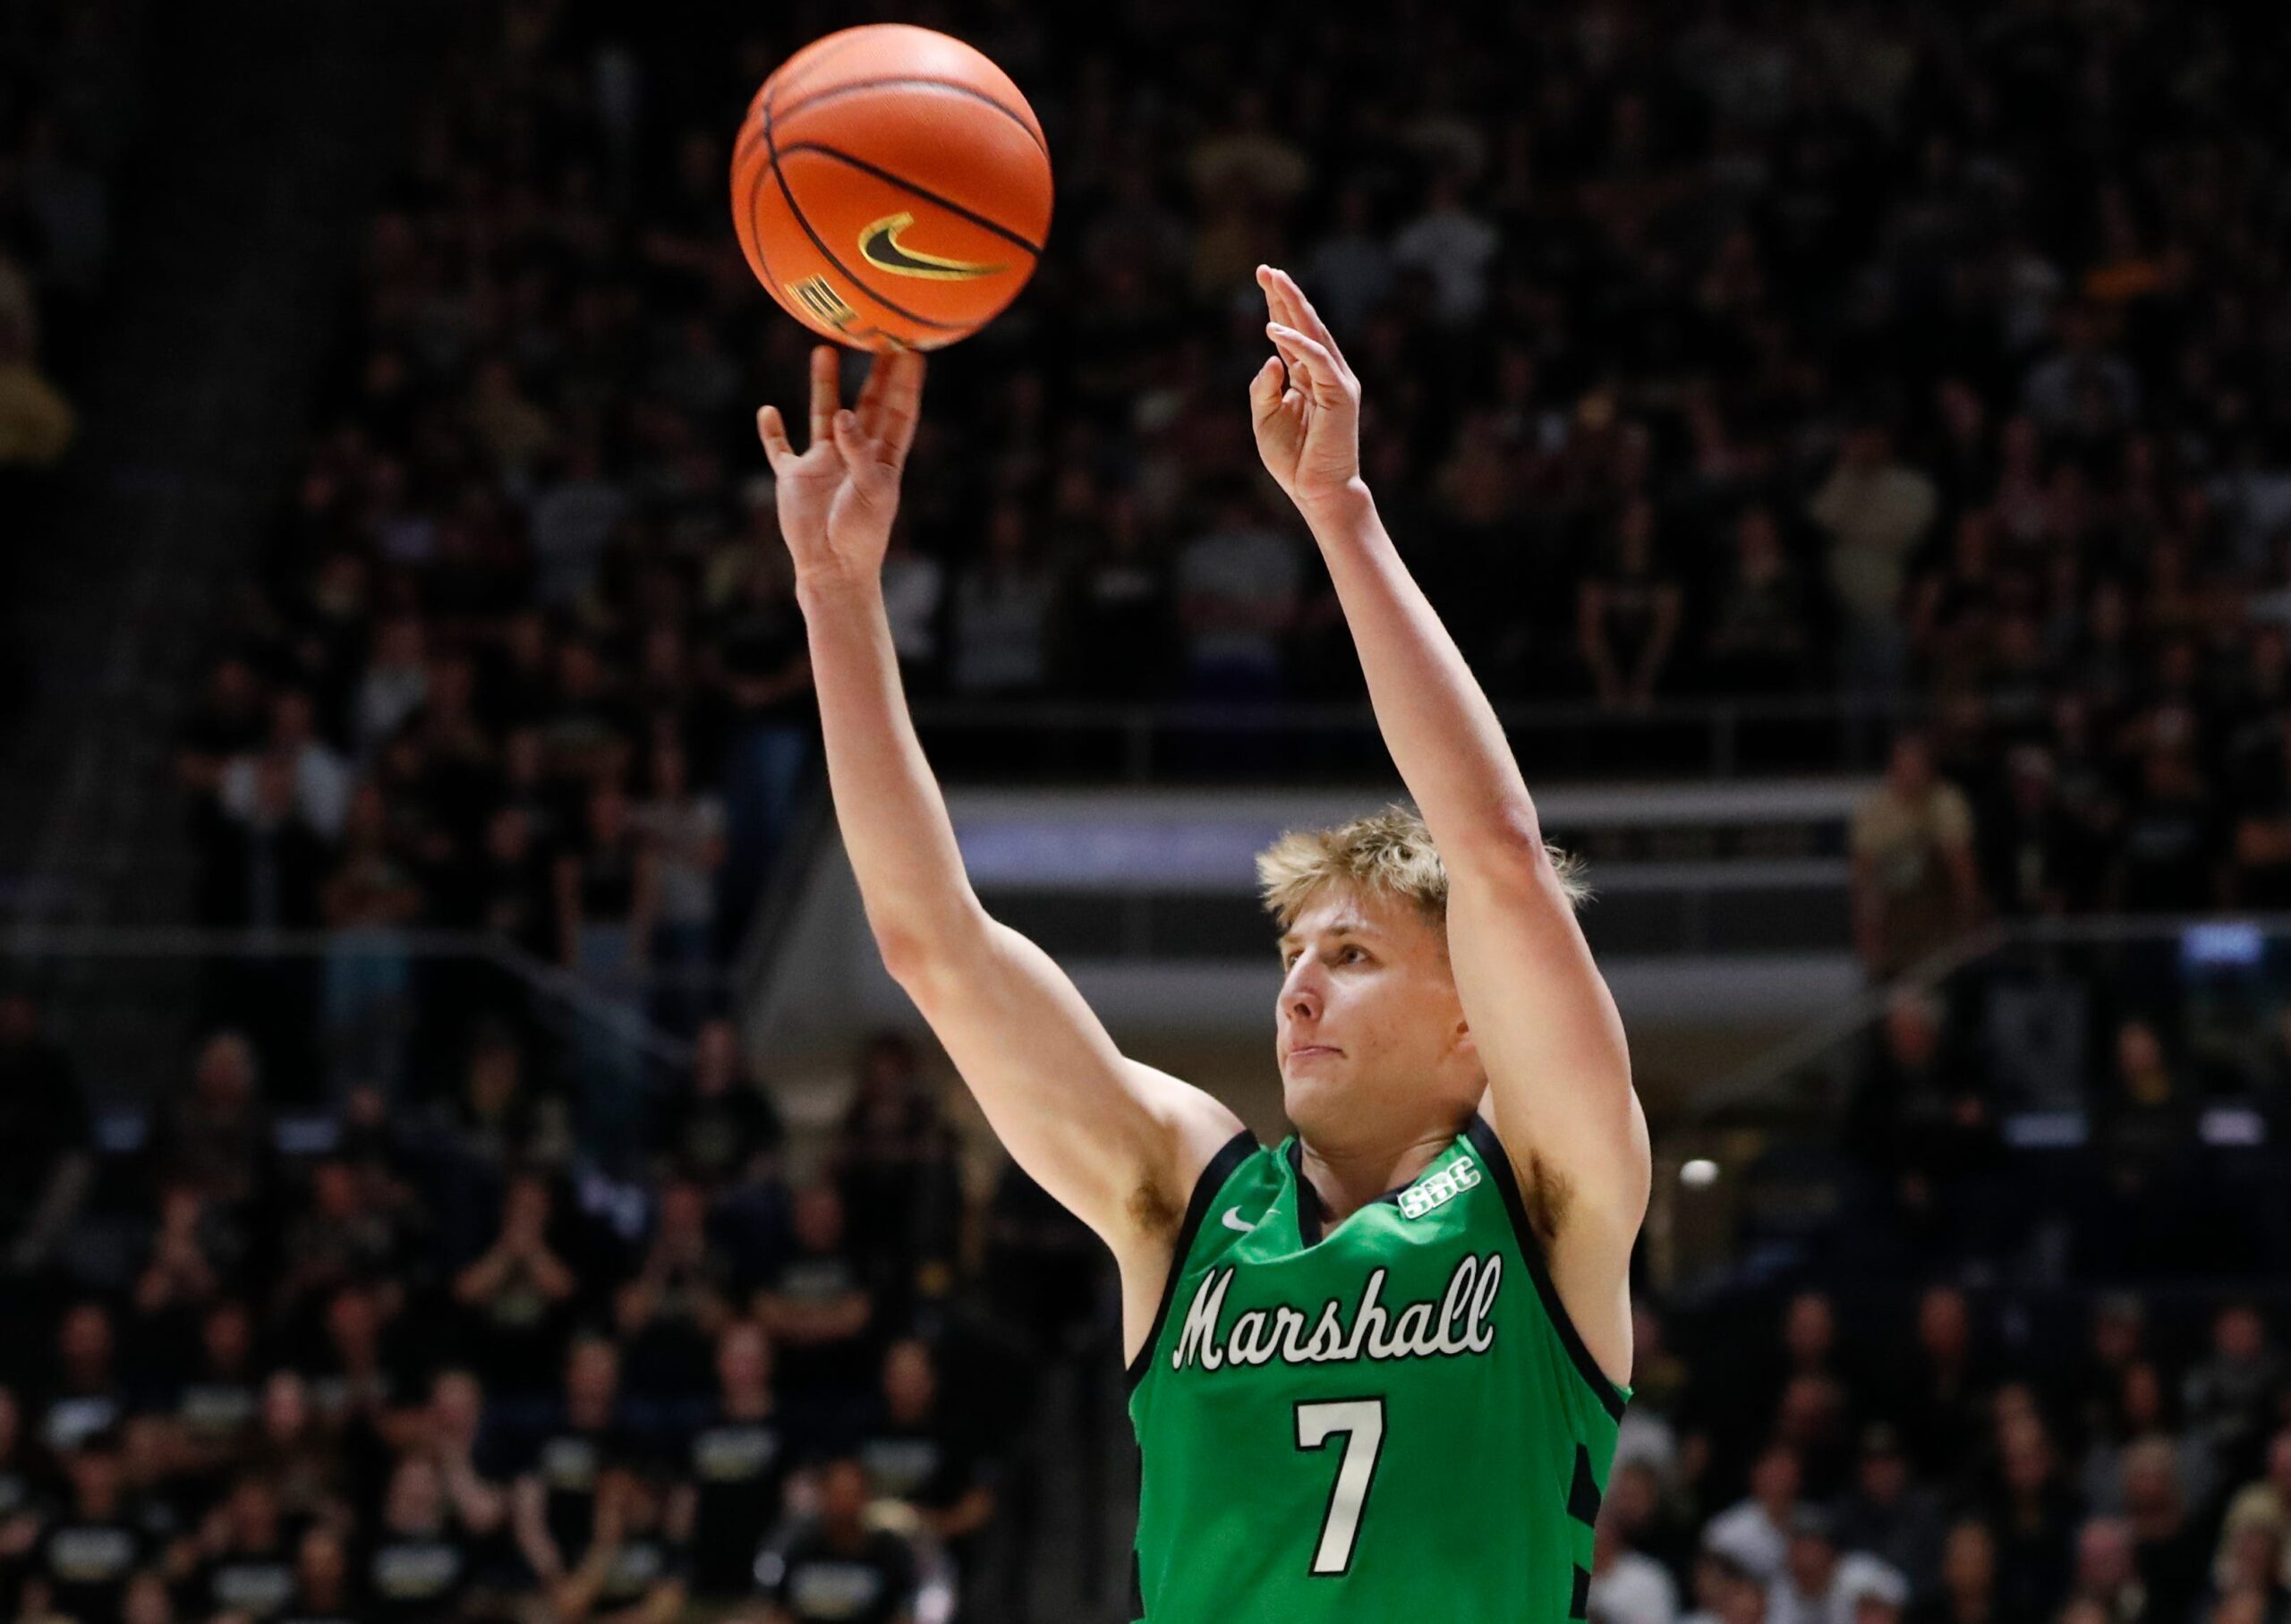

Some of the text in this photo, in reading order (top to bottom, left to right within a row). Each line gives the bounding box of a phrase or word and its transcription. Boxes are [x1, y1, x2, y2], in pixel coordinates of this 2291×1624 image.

[1397, 1155, 1482, 1220] SBC
[1171, 1253, 1503, 1372] Marshall
[1293, 1395, 1386, 1577] 7
